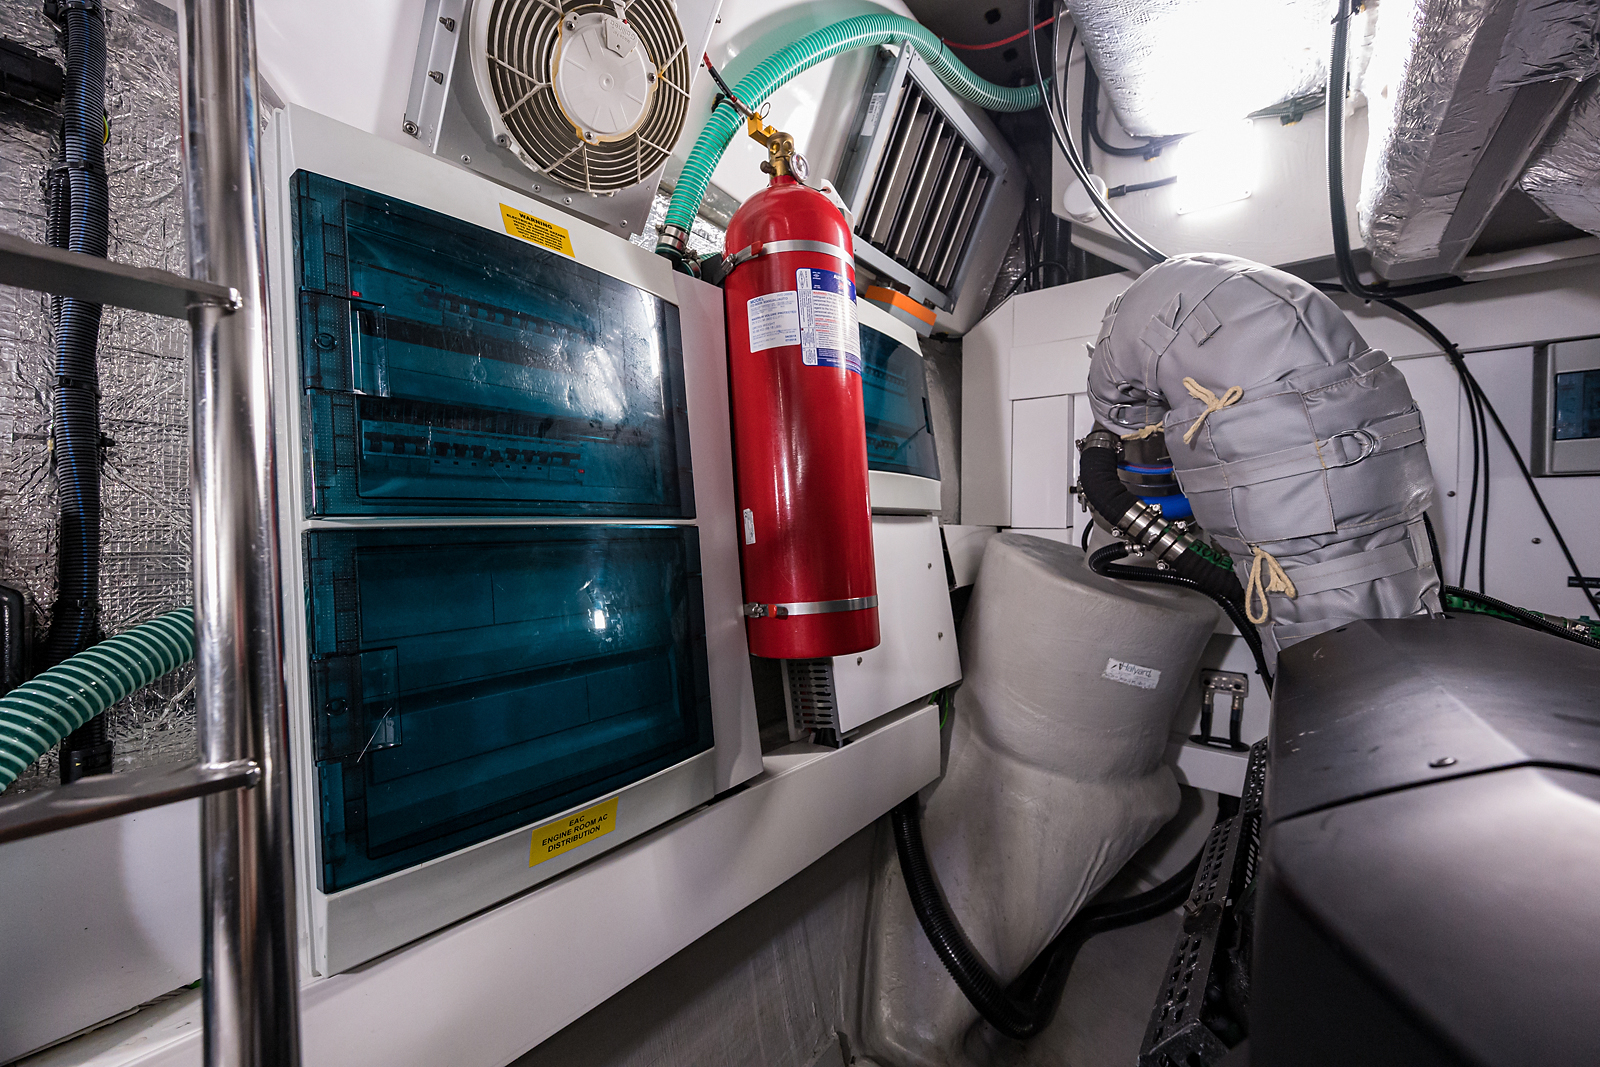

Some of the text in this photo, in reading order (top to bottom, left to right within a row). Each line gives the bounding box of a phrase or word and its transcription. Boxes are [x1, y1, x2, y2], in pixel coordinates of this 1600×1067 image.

[506, 213, 533, 226] ELECTRICAL
[518, 212, 552, 229] WARNING
[542, 813, 608, 846] ENGINE ROOM AC
[569, 815, 585, 827] EAC
[547, 824, 601, 853] DISTRIBUTION
